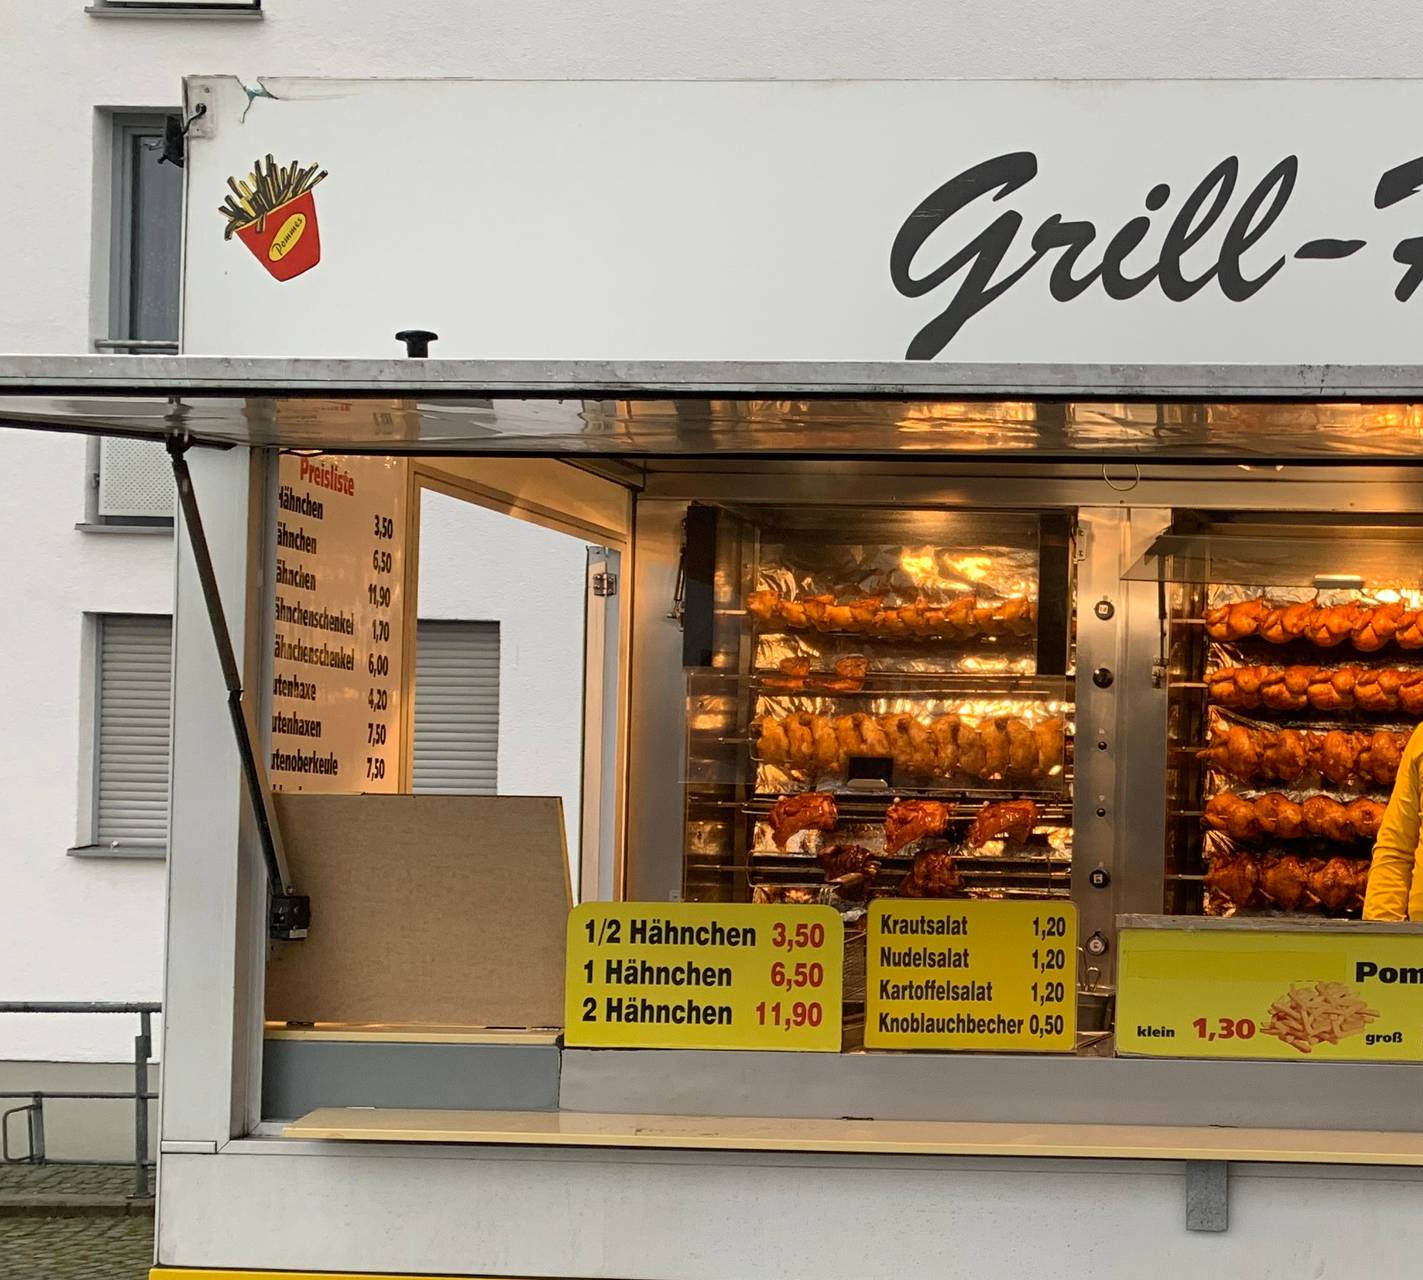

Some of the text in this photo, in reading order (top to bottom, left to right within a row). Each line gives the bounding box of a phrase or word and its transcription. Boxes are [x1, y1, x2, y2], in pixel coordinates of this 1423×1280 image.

[271, 217, 303, 256] Pommes
[300, 456, 355, 497] Preisliste
[374, 514, 394, 540] 3,50
[276, 521, 392, 574] ähnchen 6,50
[276, 558, 391, 609] ähnchen 11,90
[275, 597, 390, 643] ähnchenschenkel 1,70
[274, 634, 389, 679] ähnchenschenkel 6,00
[368, 687, 388, 712] 4,20
[272, 711, 387, 747] utenhaxen 7,50
[366, 757, 386, 781] 7,50
[585, 917, 825, 952] 1/2 Hähnchen 3,50
[881, 914, 1066, 941] Krautsalat 1,20
[583, 958, 825, 992] 1 Hähnchen 6,50
[880, 946, 1065, 974] Nudelsalat 1,20
[879, 979, 1065, 1006] Kartoffelsalat 1,20
[582, 996, 823, 1032] 2 Hähnchen 11,90
[878, 1012, 1064, 1039] Knoblauchbecher 0,50
[1137, 1017, 1256, 1042] klein 1,30
[1365, 1030, 1403, 1045] groß
